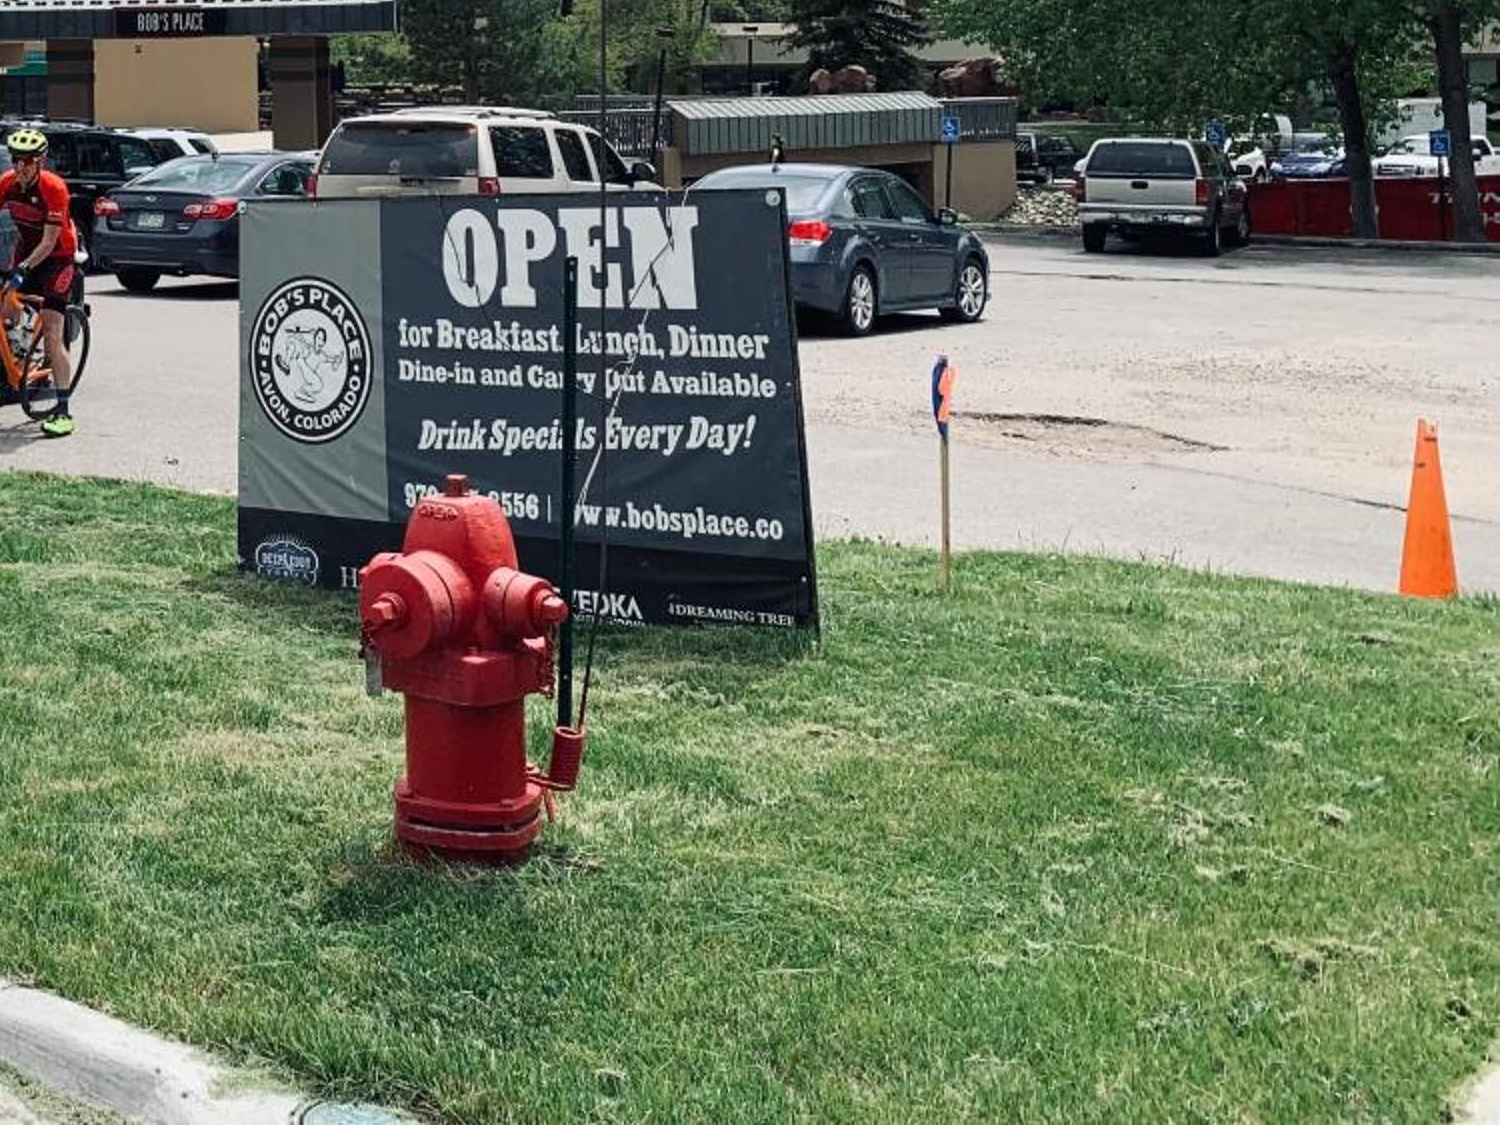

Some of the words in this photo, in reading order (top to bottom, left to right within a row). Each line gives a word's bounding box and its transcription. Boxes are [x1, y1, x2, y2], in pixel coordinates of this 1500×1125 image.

[137, 12, 169, 32] BOB'S
[172, 12, 204, 32] PLACE
[442, 206, 699, 309] OPEN
[259, 288, 305, 355] BOB'S
[309, 288, 363, 360] PLACE
[398, 318, 433, 348] for
[576, 323, 665, 359] Lunch,
[668, 324, 769, 359] Dinner
[398, 358, 476, 385] Dine-in
[481, 365, 523, 387] and
[651, 371, 777, 398] Available
[259, 370, 292, 423] AVON,
[294, 375, 361, 430] COLORADO
[418, 418, 486, 450] Drink
[488, 418, 596, 456] Specils
[605, 416, 683, 456] Every
[686, 415, 757, 456] Day!
[675, 604, 755, 622] DREAMING
